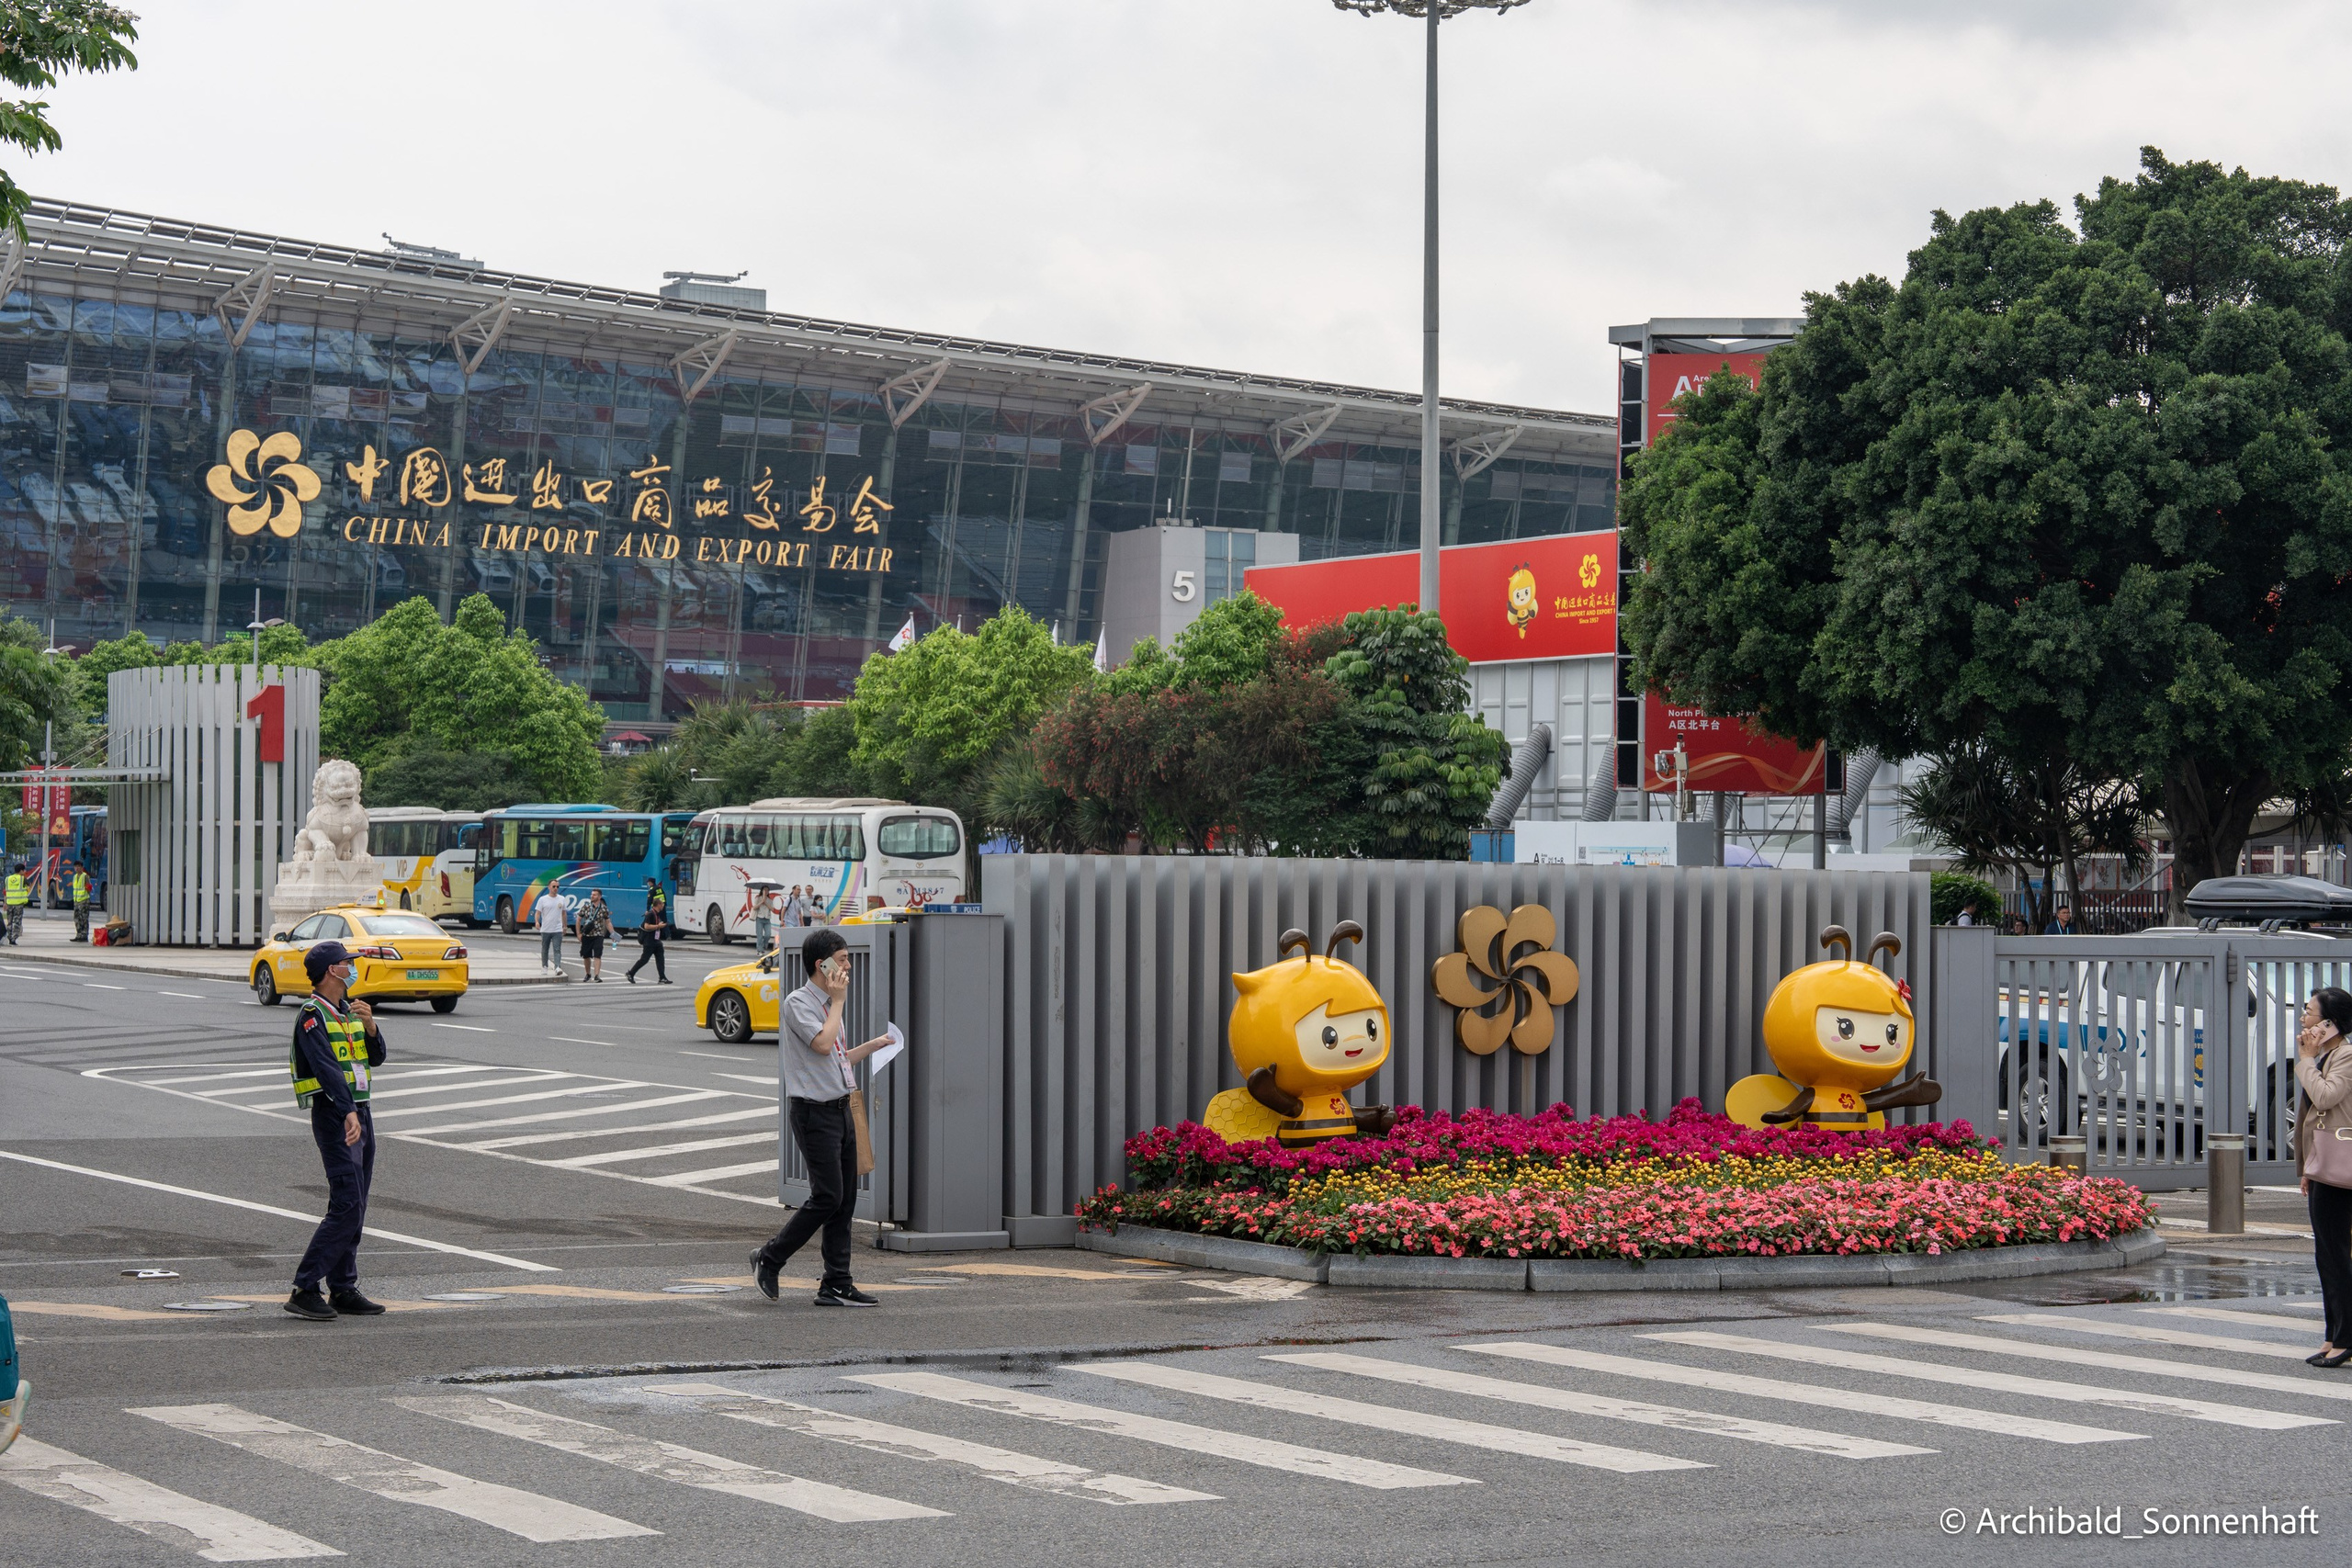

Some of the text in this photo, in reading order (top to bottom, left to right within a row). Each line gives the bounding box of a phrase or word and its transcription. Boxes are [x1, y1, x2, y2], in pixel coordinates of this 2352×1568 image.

[344, 515, 894, 572] CHINA IMPORT AND EXPORT FAIR
[1171, 570, 1195, 602] 5
[1668, 709, 1693, 717] North
[246, 684, 285, 762] 1
[1668, 719, 1721, 730] A区北平台
[396, 859, 408, 878] VIP
[963, 906, 980, 914] POLICE
